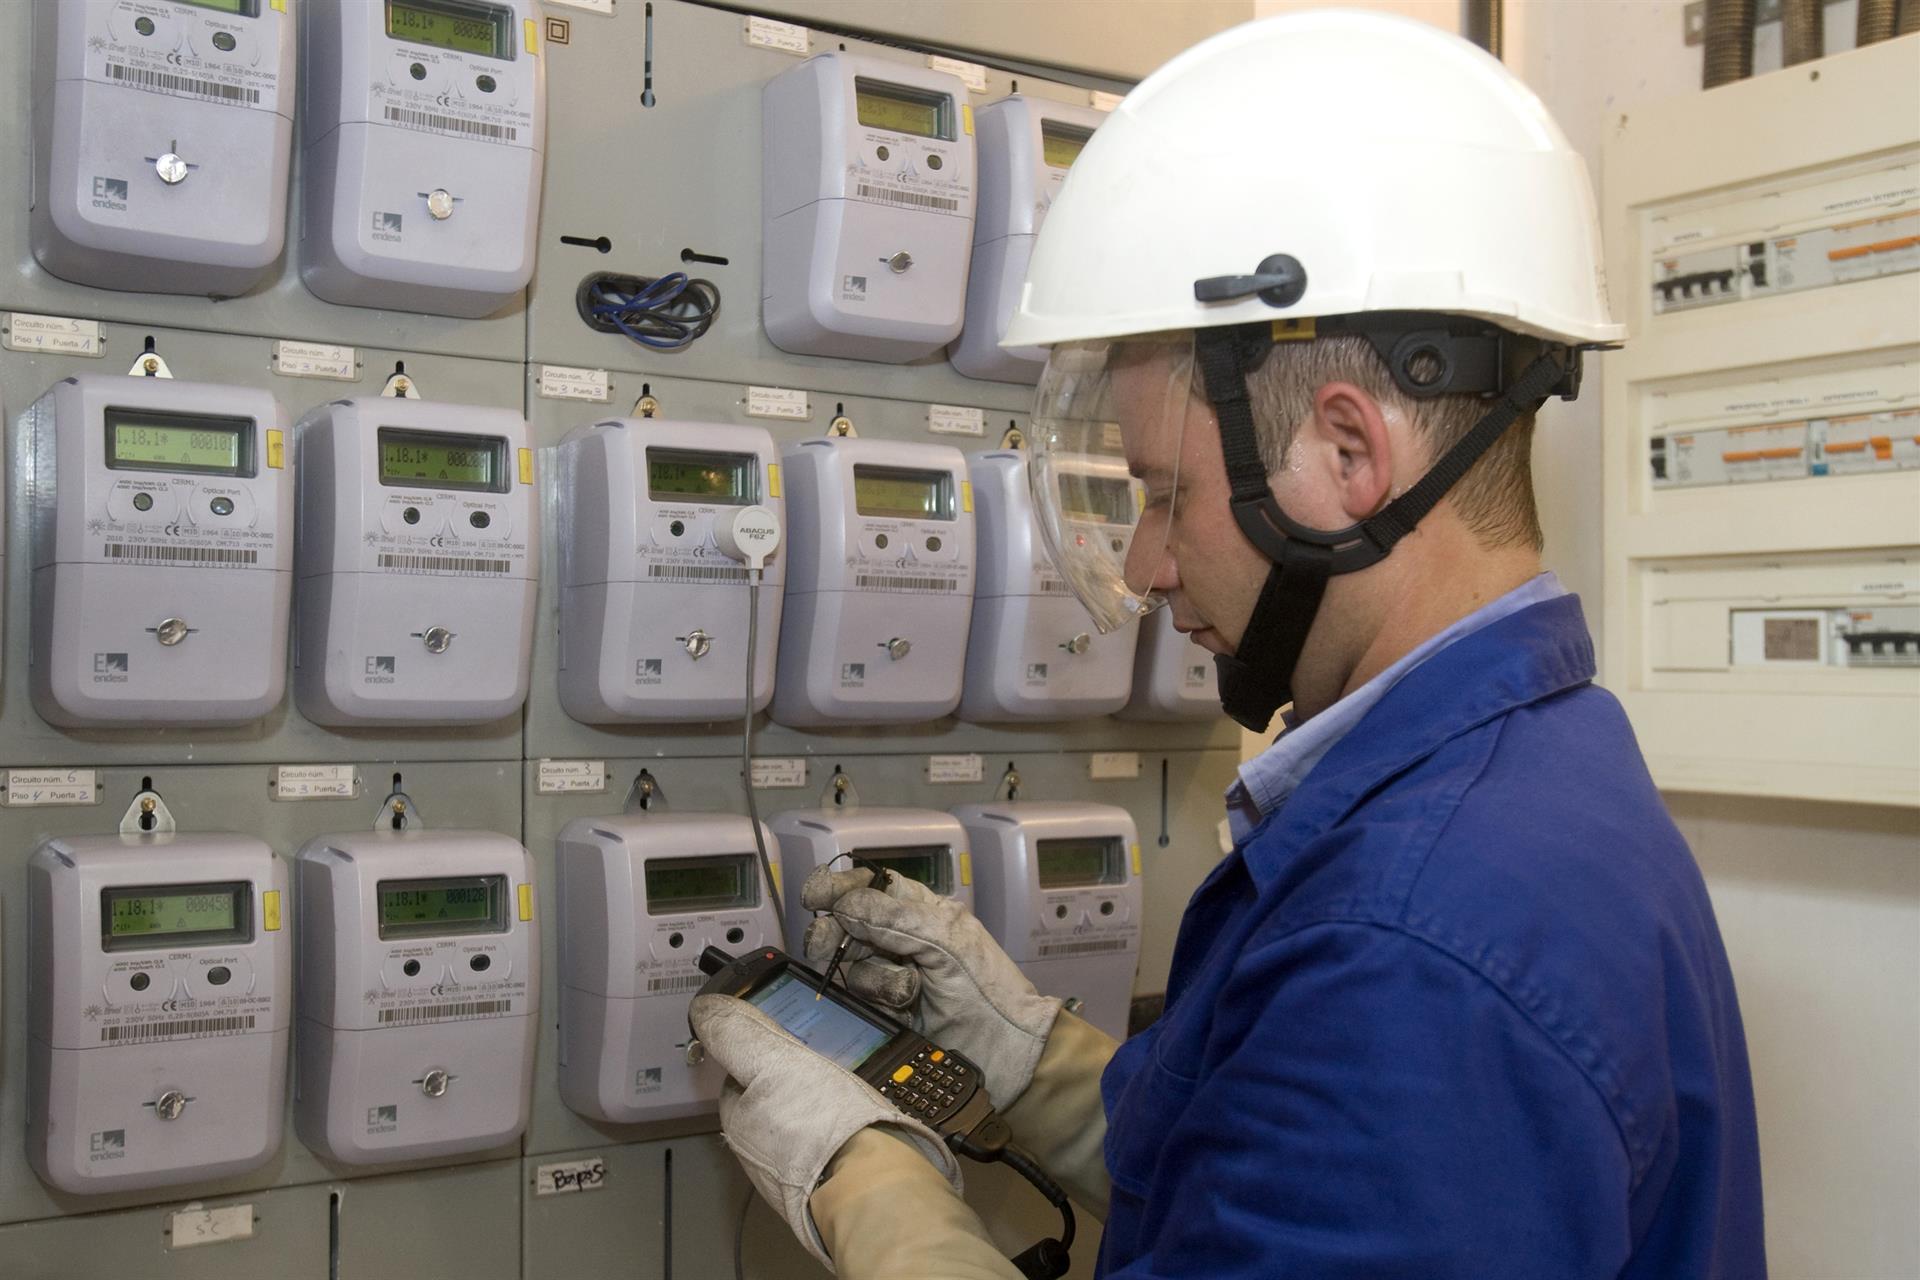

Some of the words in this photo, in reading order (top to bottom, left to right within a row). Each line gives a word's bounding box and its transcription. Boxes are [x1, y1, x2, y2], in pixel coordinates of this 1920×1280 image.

[92, 198, 127, 211] endesa
[14, 319, 44, 329] Circuito
[14, 335, 32, 344] Piso
[54, 338, 78, 348] Puerta
[282, 360, 296, 369] Piso
[68, 769, 76, 783] 6
[336, 784, 348, 794] 2
[79, 791, 88, 800] 2
